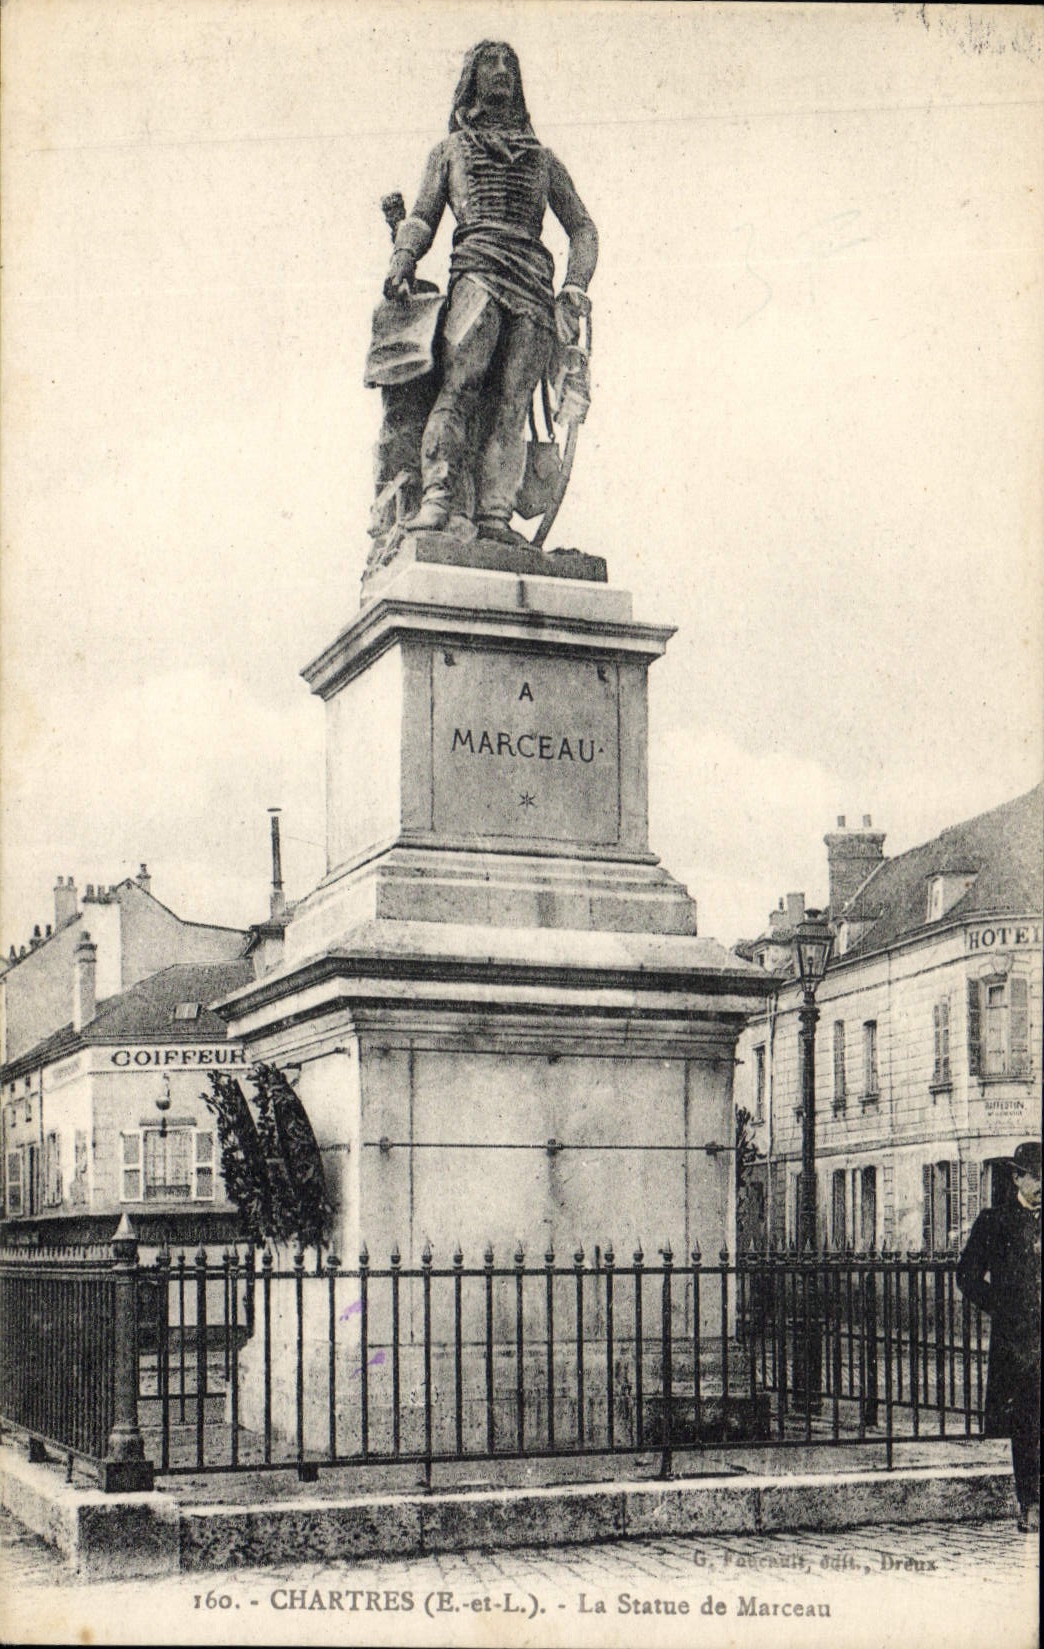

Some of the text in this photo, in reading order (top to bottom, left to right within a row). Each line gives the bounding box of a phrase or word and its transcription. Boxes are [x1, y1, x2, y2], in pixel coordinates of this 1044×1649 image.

[518, 682, 534, 702] A
[968, 926, 1042, 950] HOTEL
[111, 1049, 247, 1067] COIFFEUR
